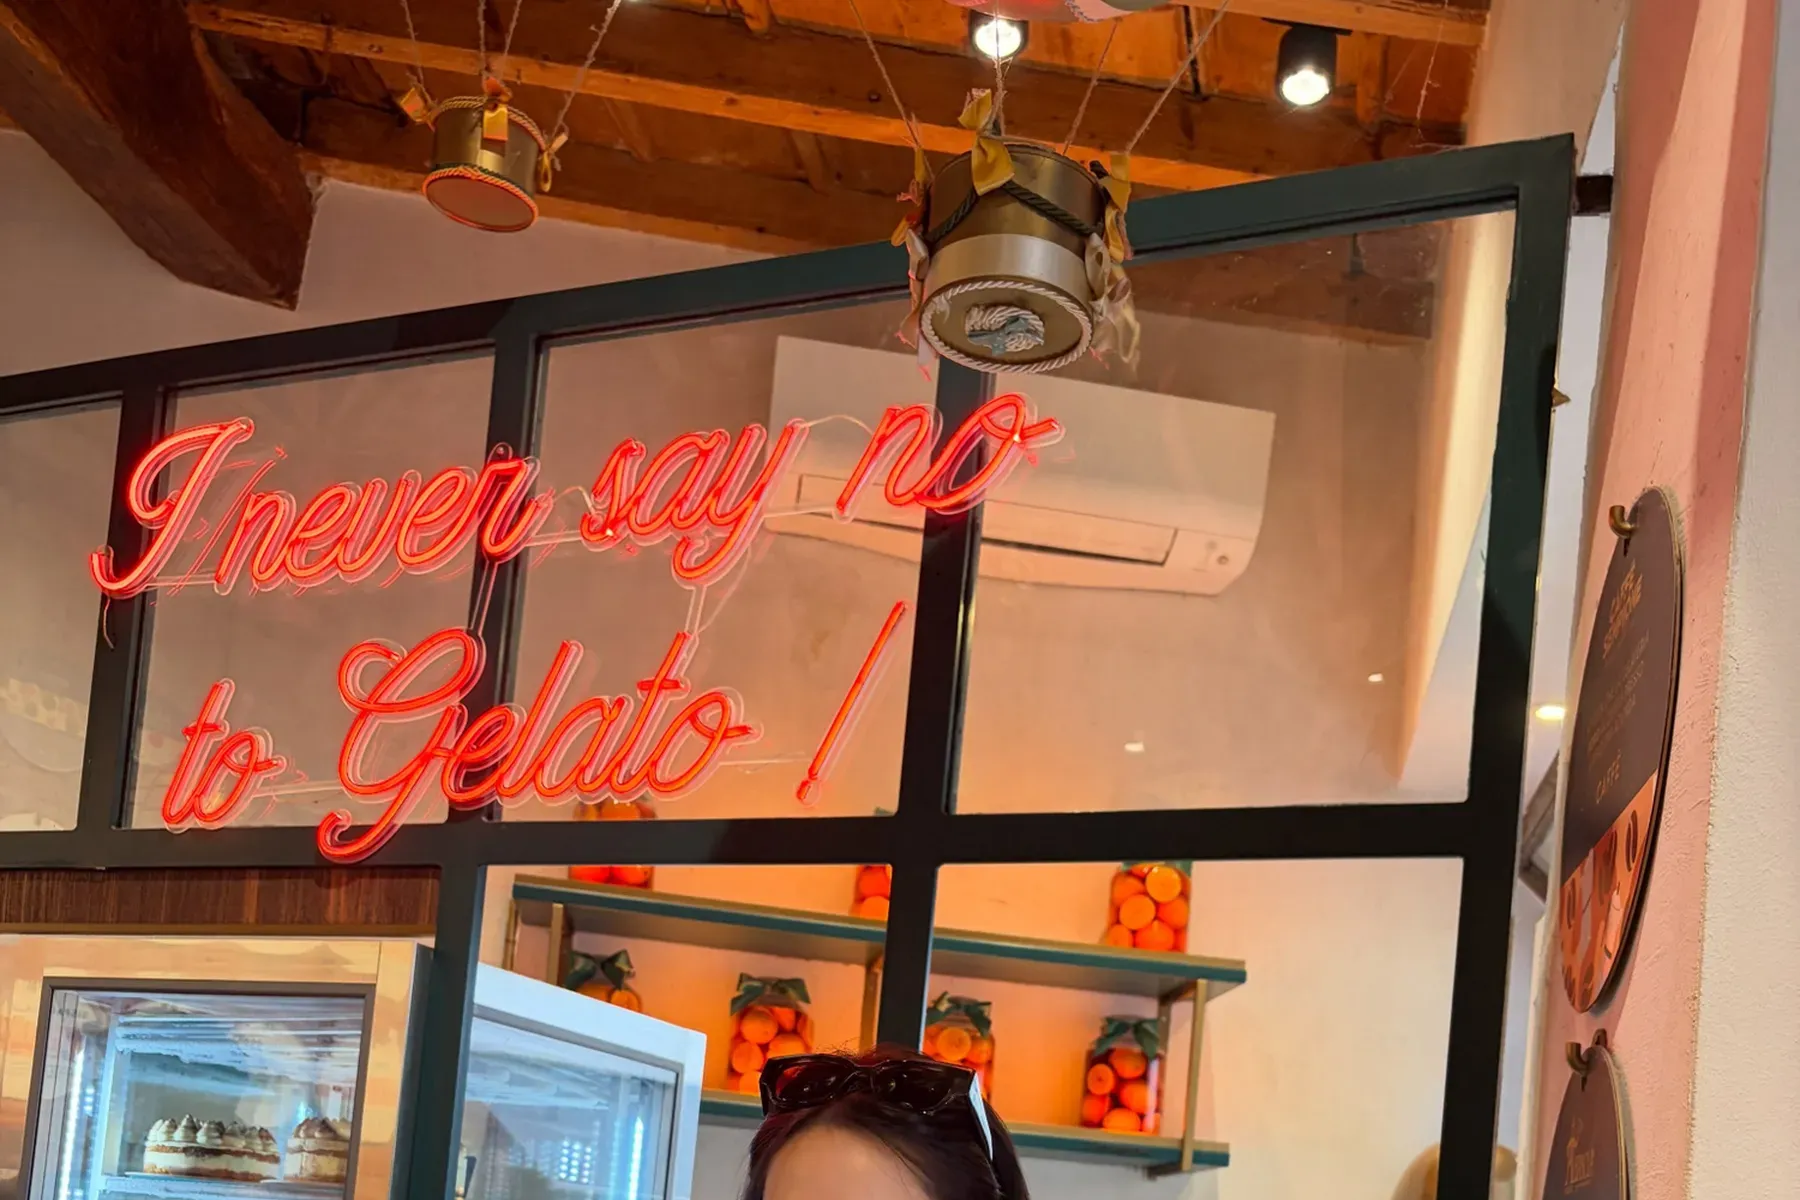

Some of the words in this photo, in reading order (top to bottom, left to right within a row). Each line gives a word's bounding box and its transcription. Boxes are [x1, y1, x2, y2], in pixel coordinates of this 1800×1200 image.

[90, 417, 254, 598] I
[213, 456, 546, 590] never
[579, 420, 805, 582] say
[836, 392, 1062, 516] no
[162, 679, 284, 829] to
[317, 626, 757, 862] Gelato
